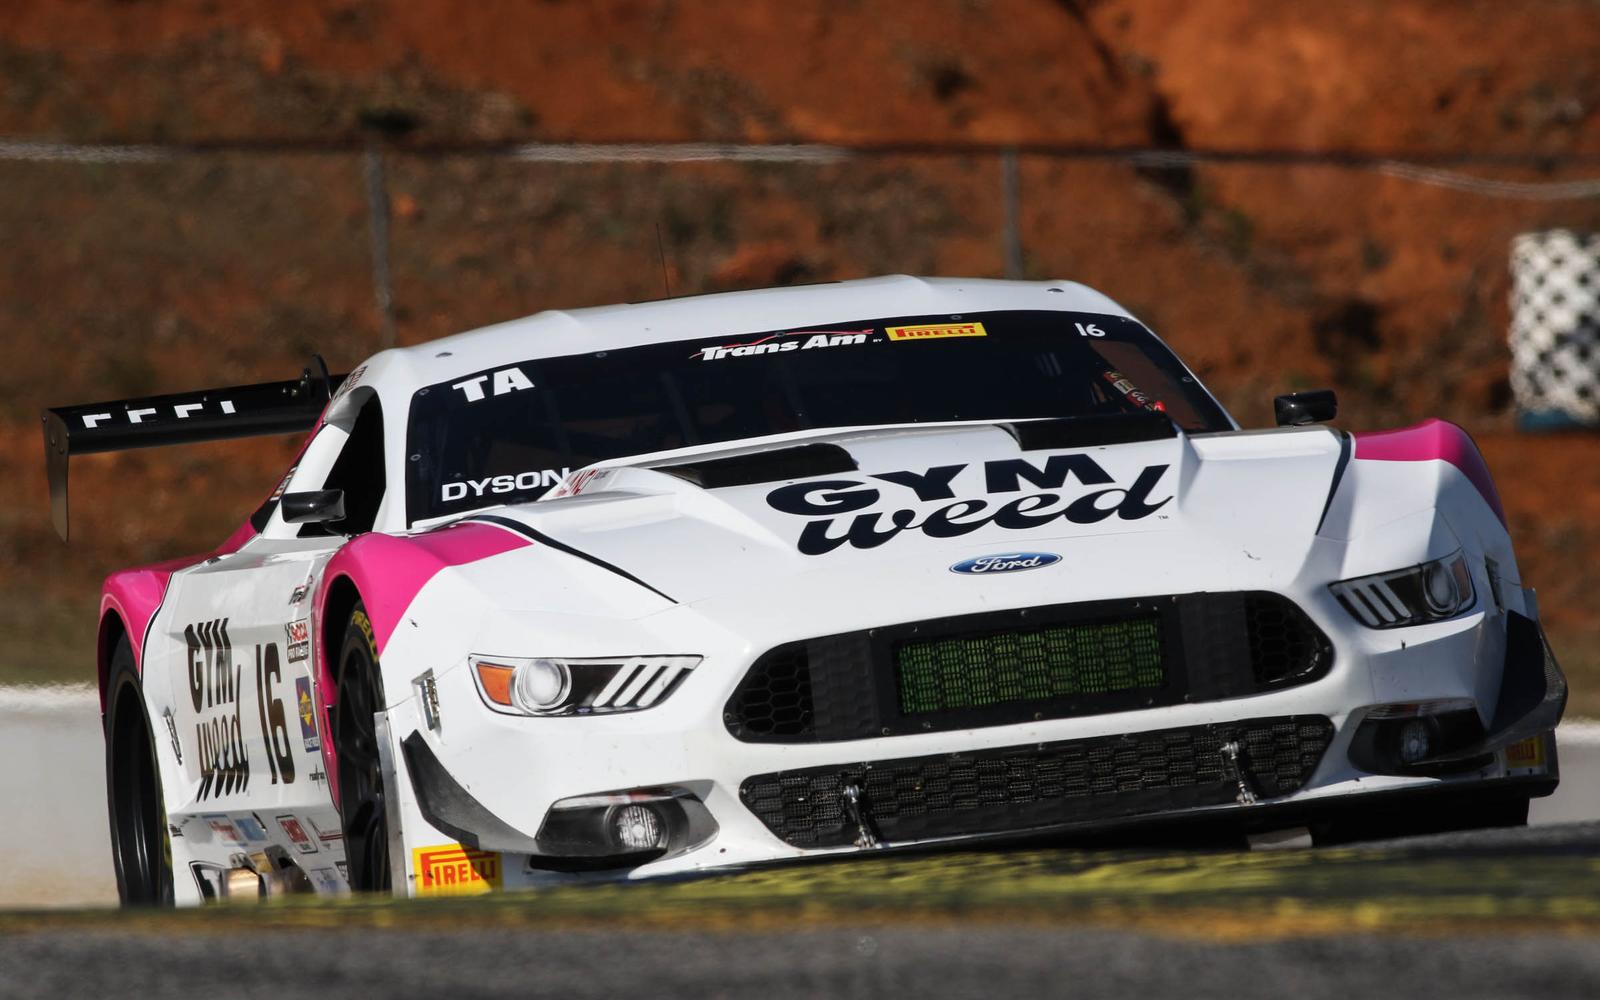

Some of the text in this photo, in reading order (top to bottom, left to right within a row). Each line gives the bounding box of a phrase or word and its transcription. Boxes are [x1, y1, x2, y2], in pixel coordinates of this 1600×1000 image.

[896, 325, 976, 338] PIRELLI
[1074, 322, 1106, 337] 16
[701, 340, 799, 361] Trans
[801, 334, 867, 350] Am
[452, 367, 535, 402] TA
[442, 467, 570, 501] DYSON
[766, 453, 1116, 516] GYM
[797, 464, 1174, 556] weed
[970, 553, 1043, 573] Ford
[256, 642, 295, 784] 16
[420, 850, 496, 889] PIRELLI
